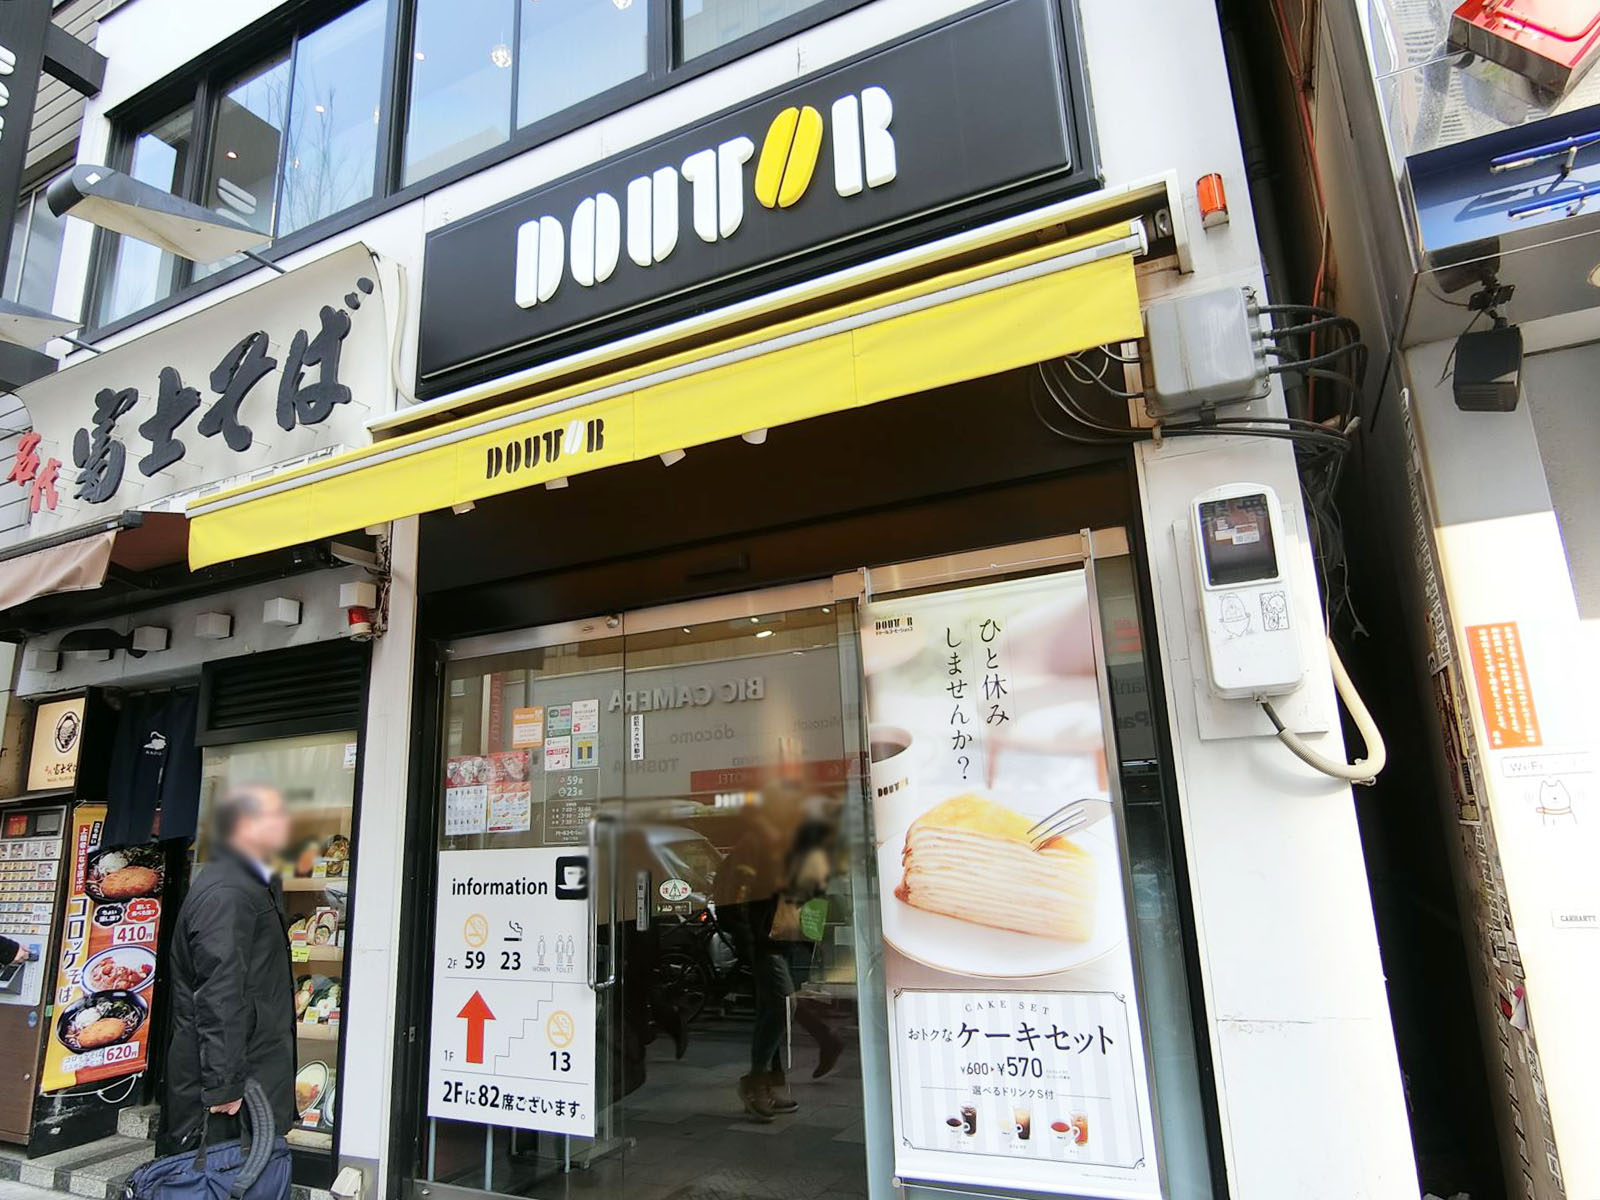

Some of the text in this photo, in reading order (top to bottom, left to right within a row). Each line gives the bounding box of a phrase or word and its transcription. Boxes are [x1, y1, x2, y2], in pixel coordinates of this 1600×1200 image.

[515, 86, 897, 309] DOUTOR
[73, 277, 374, 503] 富士そば
[486, 418, 605, 479] DOUTOR
[979, 618, 1009, 726] ひと休み
[946, 627, 973, 780] しませんか？
[452, 877, 548, 896] information
[117, 925, 153, 942] 410円
[59, 898, 88, 1004] コロッケそば
[447, 951, 521, 970] 2F 59 23
[964, 1000, 1050, 1015] CAKE SET
[908, 1022, 1114, 1055] おトクなケーキセット
[444, 1049, 454, 1061] 1F
[550, 1050, 571, 1072] 13
[960, 1062, 989, 1076] ¥600
[997, 1056, 1043, 1077] ¥570
[442, 1080, 586, 1120] 2Fに82席ございます。
[972, 1085, 1054, 1100] 選べるドリンクS付
